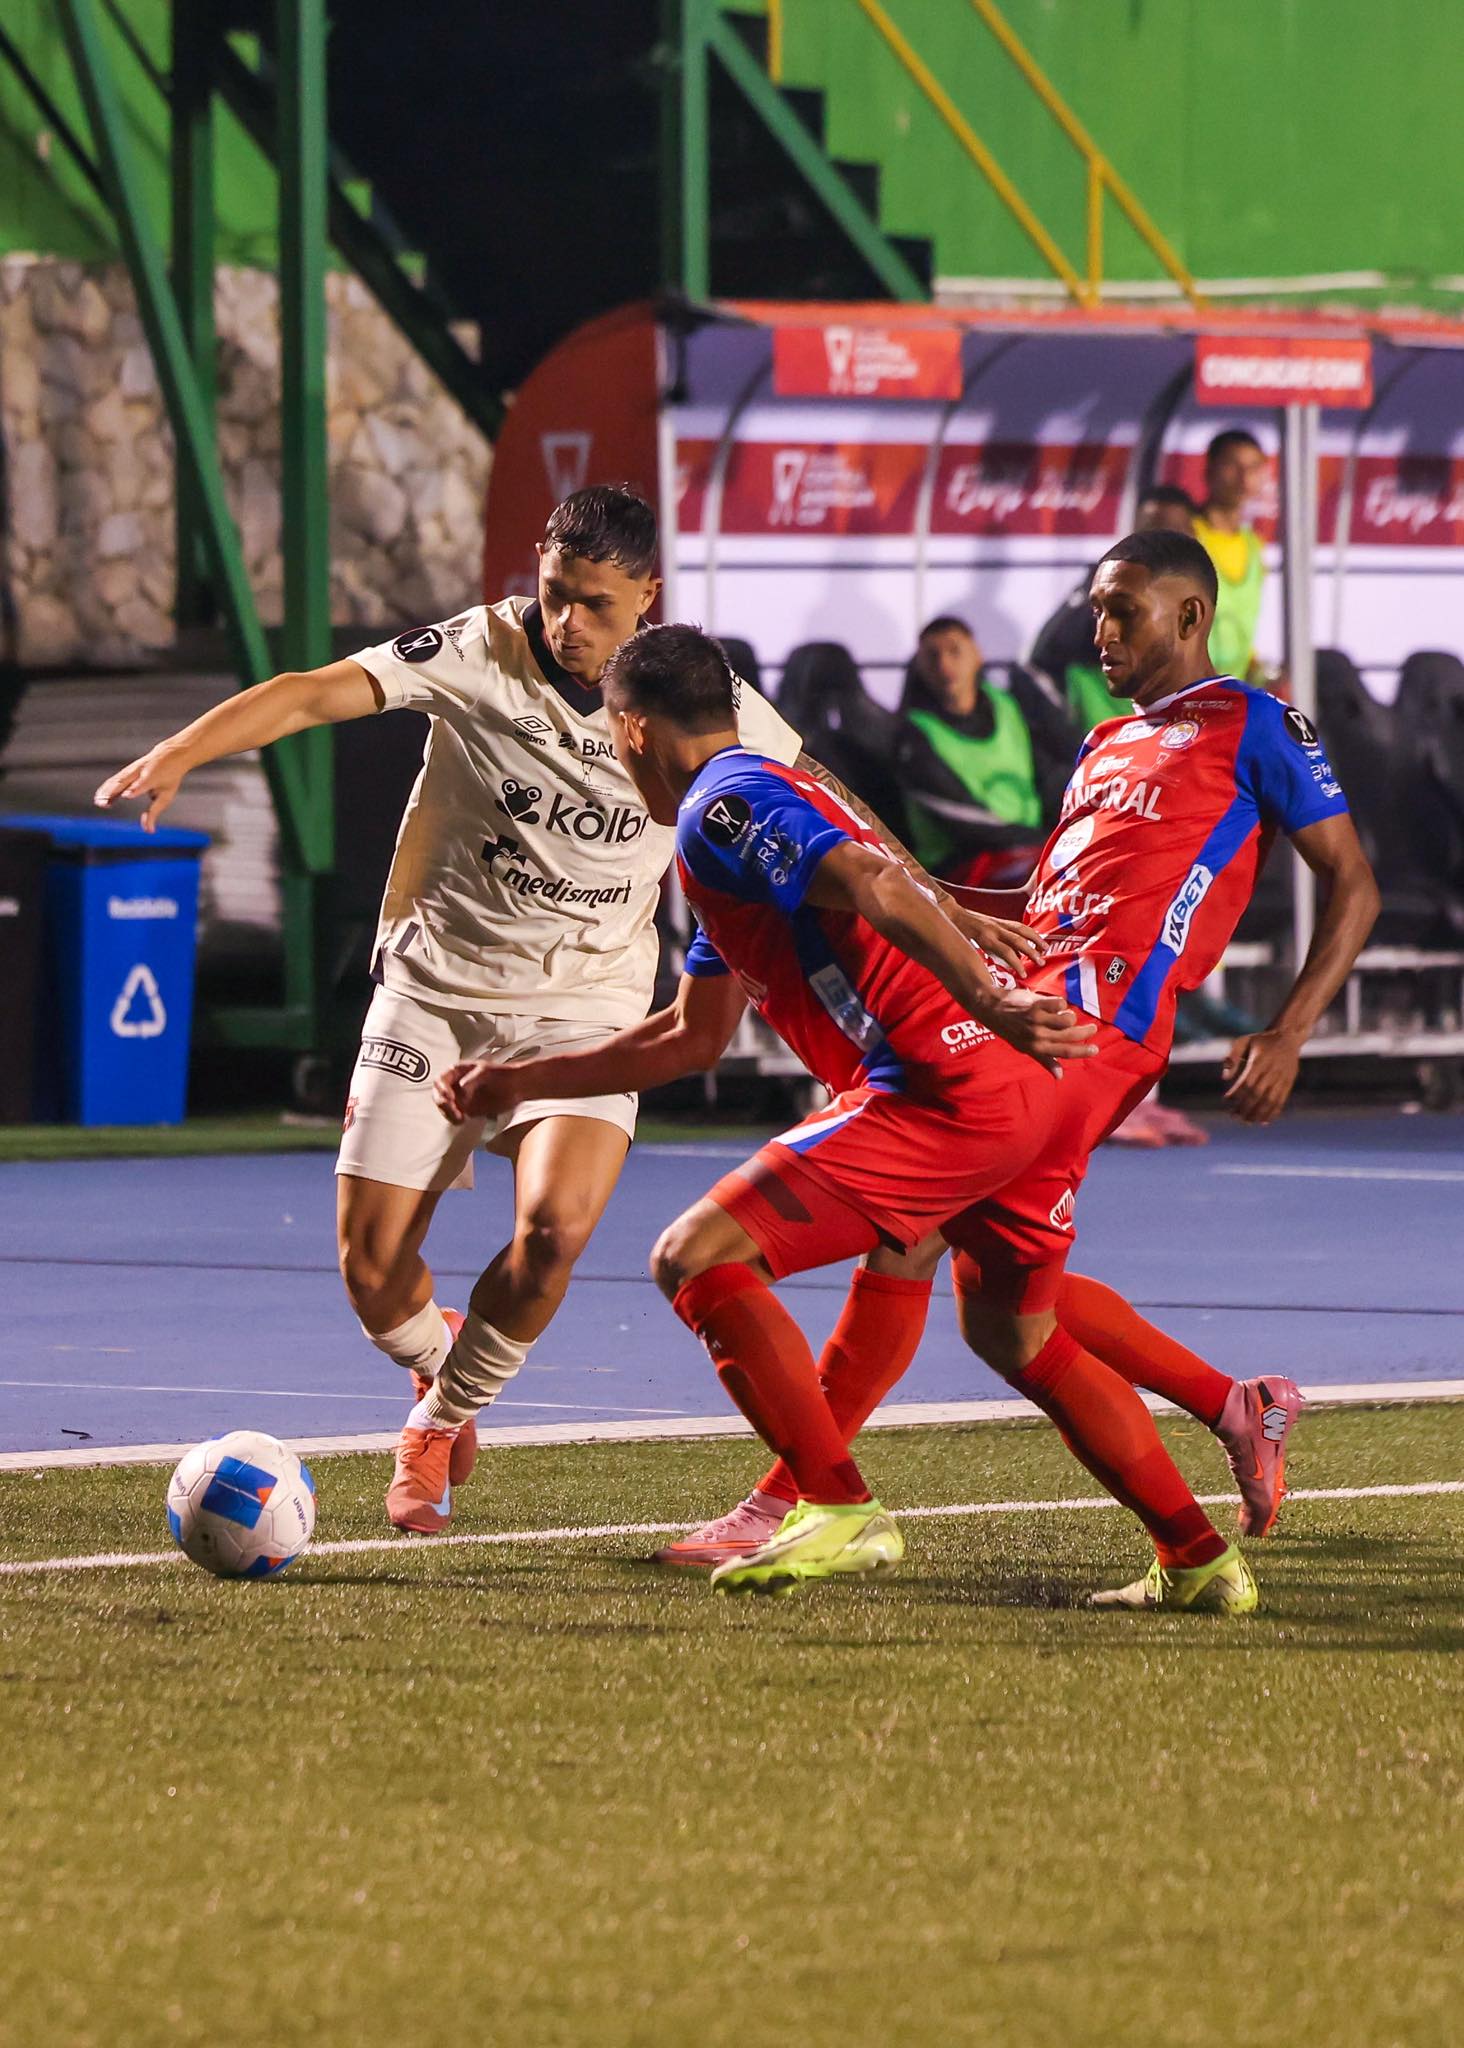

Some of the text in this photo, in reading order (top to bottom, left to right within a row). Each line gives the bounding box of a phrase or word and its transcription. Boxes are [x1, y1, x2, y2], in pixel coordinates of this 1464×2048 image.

[514, 729, 547, 746] umbro
[502, 867, 632, 909] medismart
[1168, 870, 1204, 948] 1XBET
